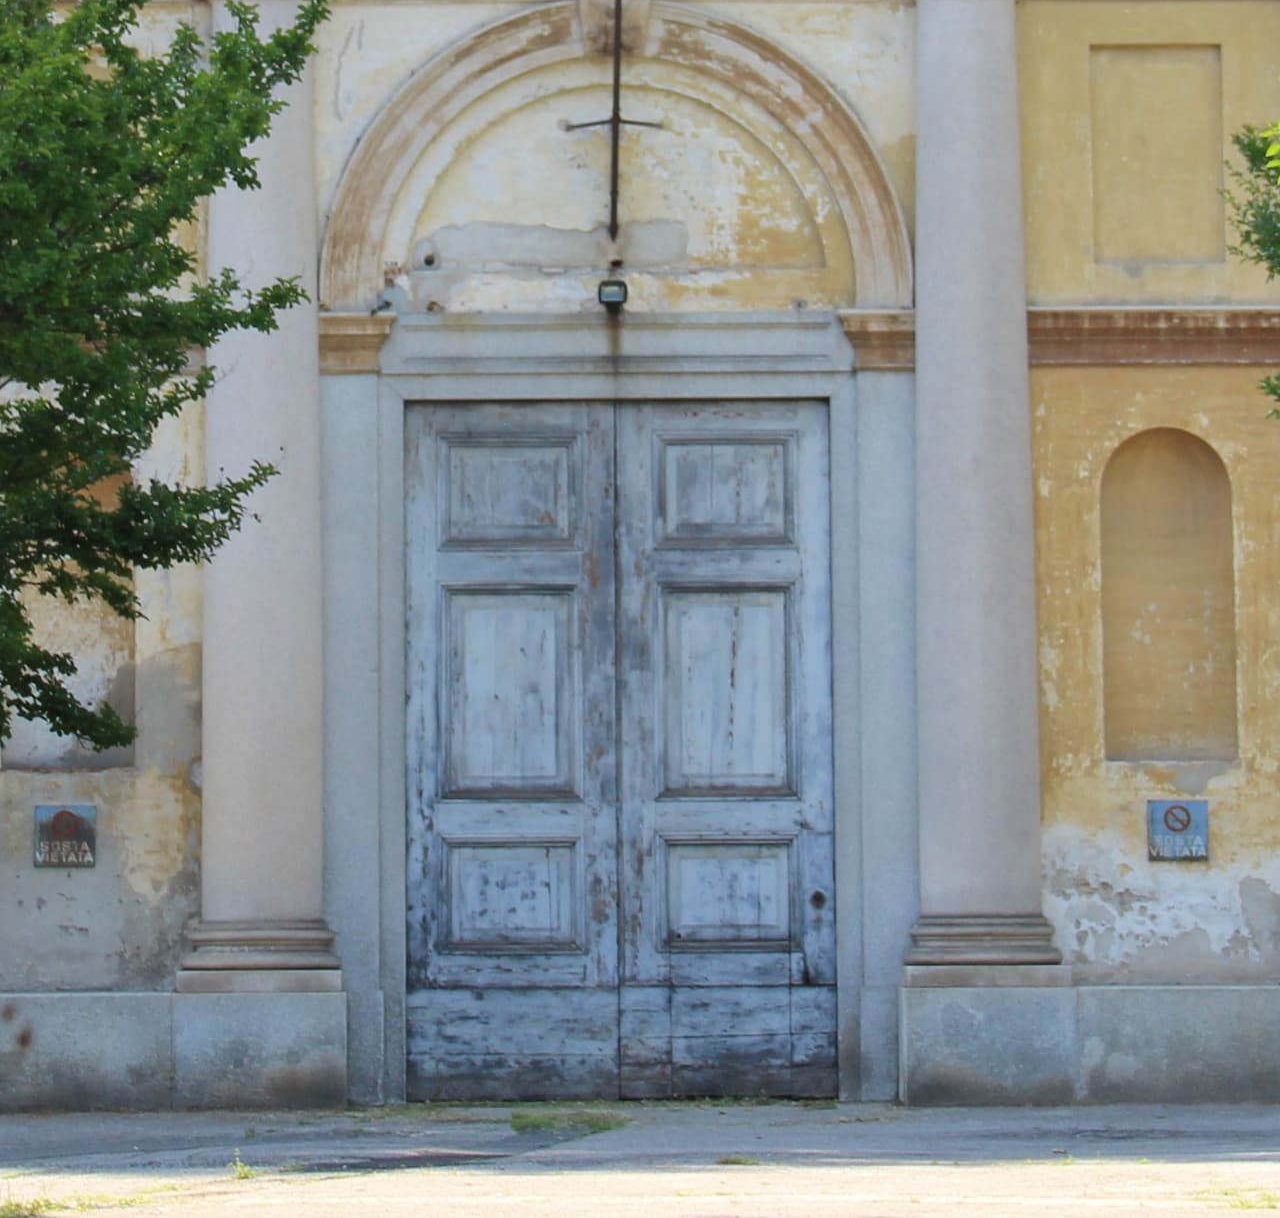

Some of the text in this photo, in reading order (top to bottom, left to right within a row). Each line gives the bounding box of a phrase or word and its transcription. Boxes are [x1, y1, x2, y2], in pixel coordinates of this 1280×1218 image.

[40, 841, 90, 852] SOSTA
[1149, 845, 1207, 857] VIETATA
[35, 851, 94, 863] VIETATA
